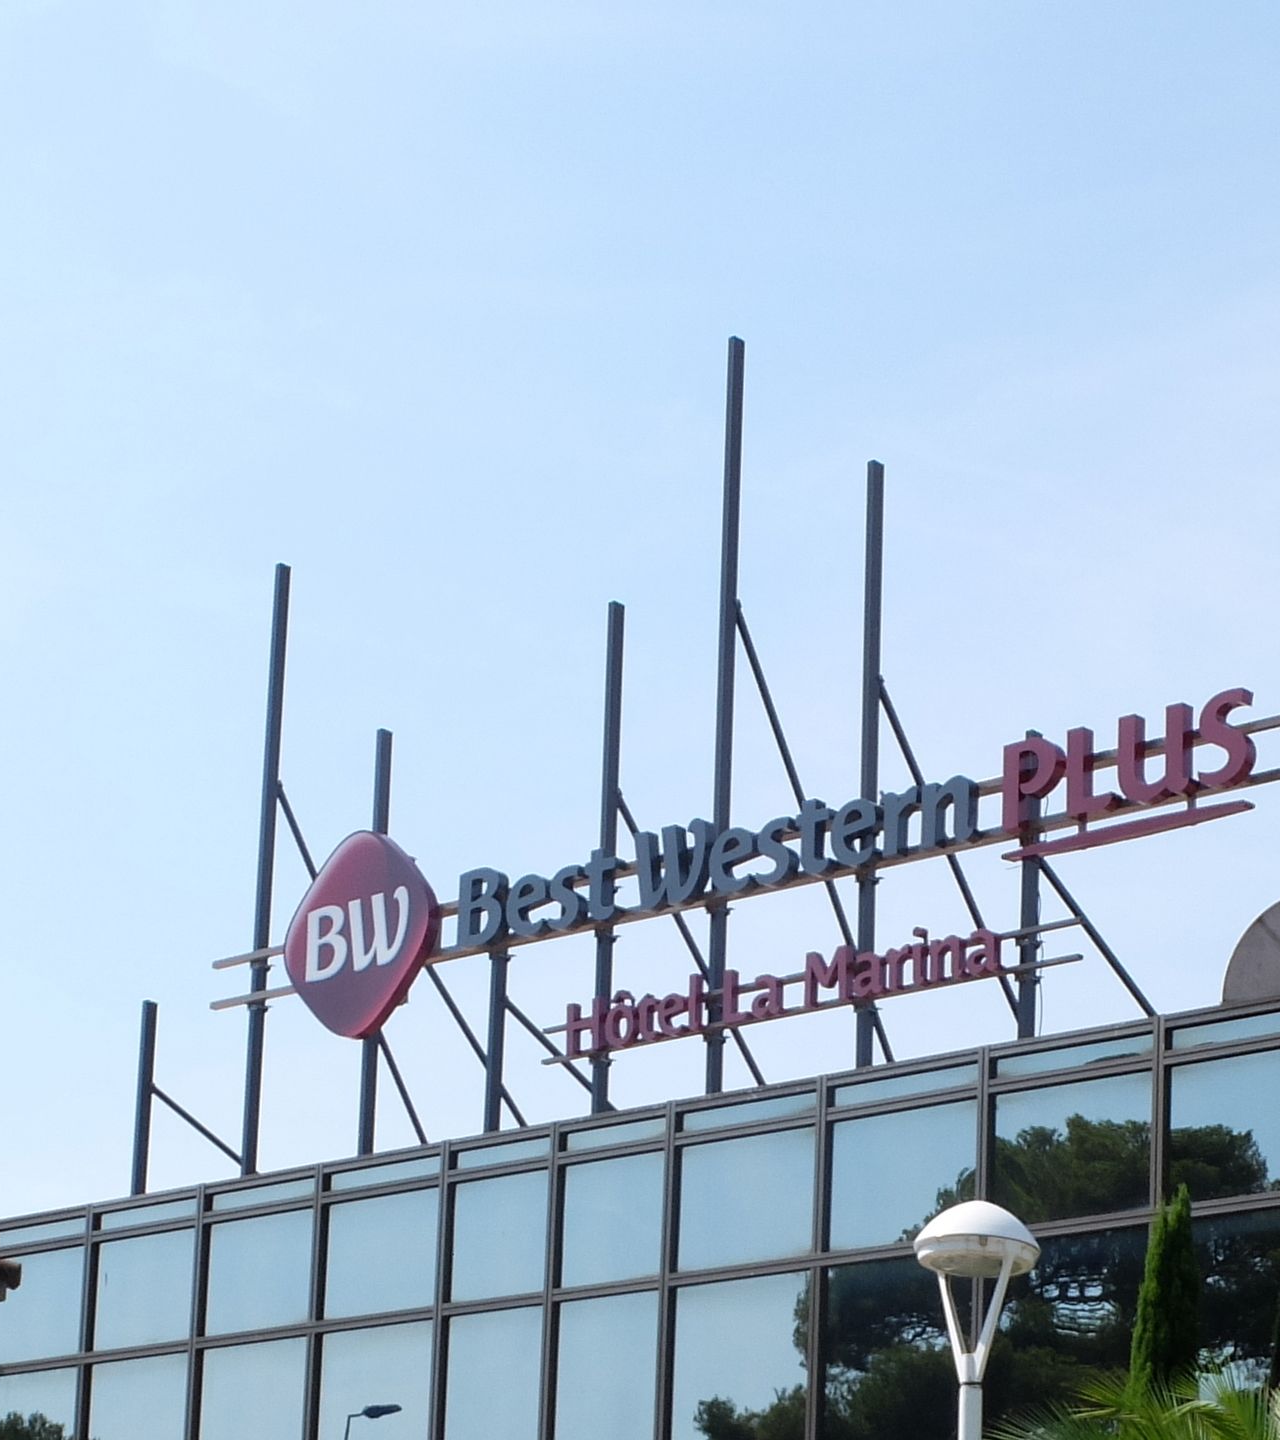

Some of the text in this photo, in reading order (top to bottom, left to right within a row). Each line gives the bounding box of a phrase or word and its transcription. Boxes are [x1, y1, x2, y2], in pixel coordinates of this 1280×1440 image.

[456, 687, 1257, 949] Best Western PLUS
[304, 885, 410, 983] BW
[565, 926, 1002, 1058] Hôtel La Marina
